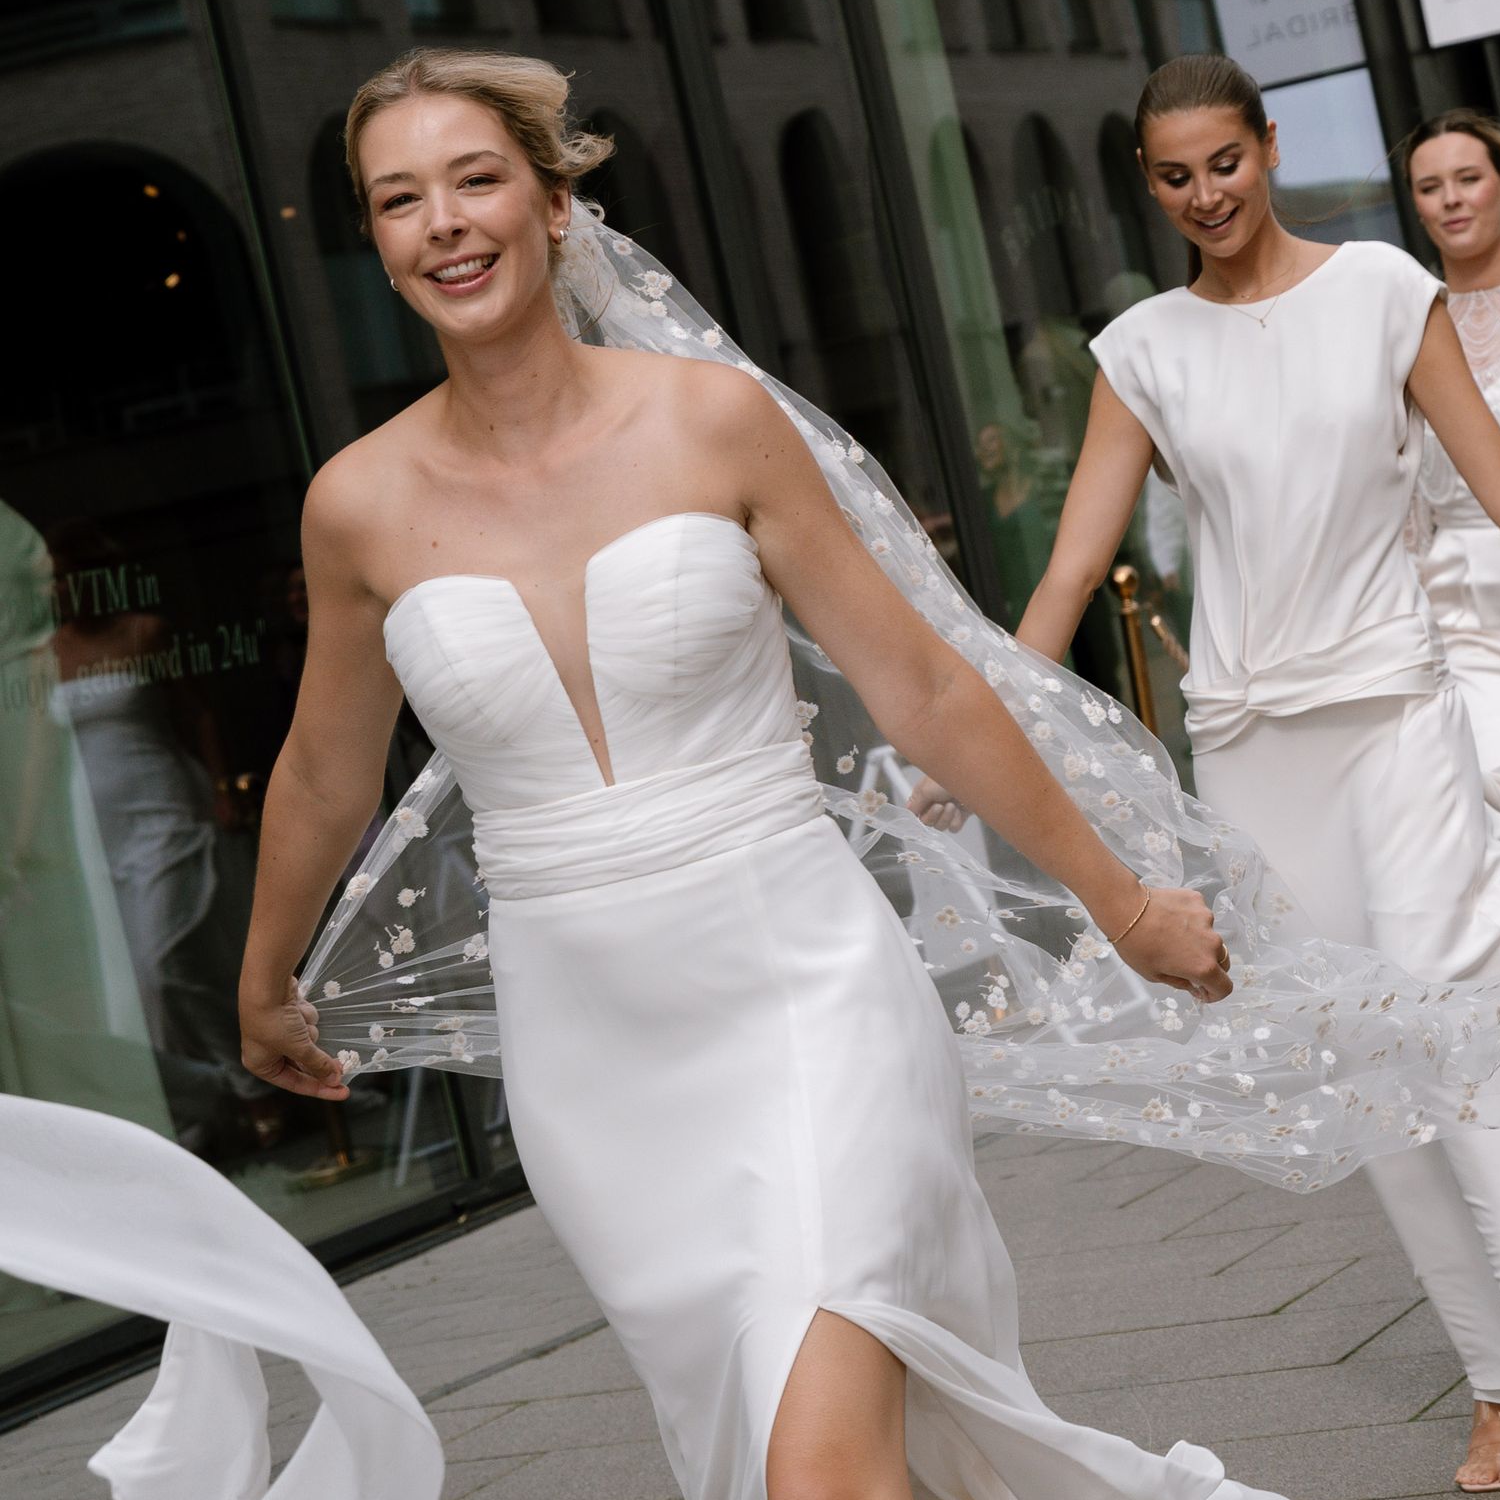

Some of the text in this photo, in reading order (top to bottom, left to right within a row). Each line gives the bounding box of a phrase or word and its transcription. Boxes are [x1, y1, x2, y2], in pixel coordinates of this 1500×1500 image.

[66, 563, 130, 617] VTM
[134, 562, 161, 607] in
[187, 631, 213, 675] in
